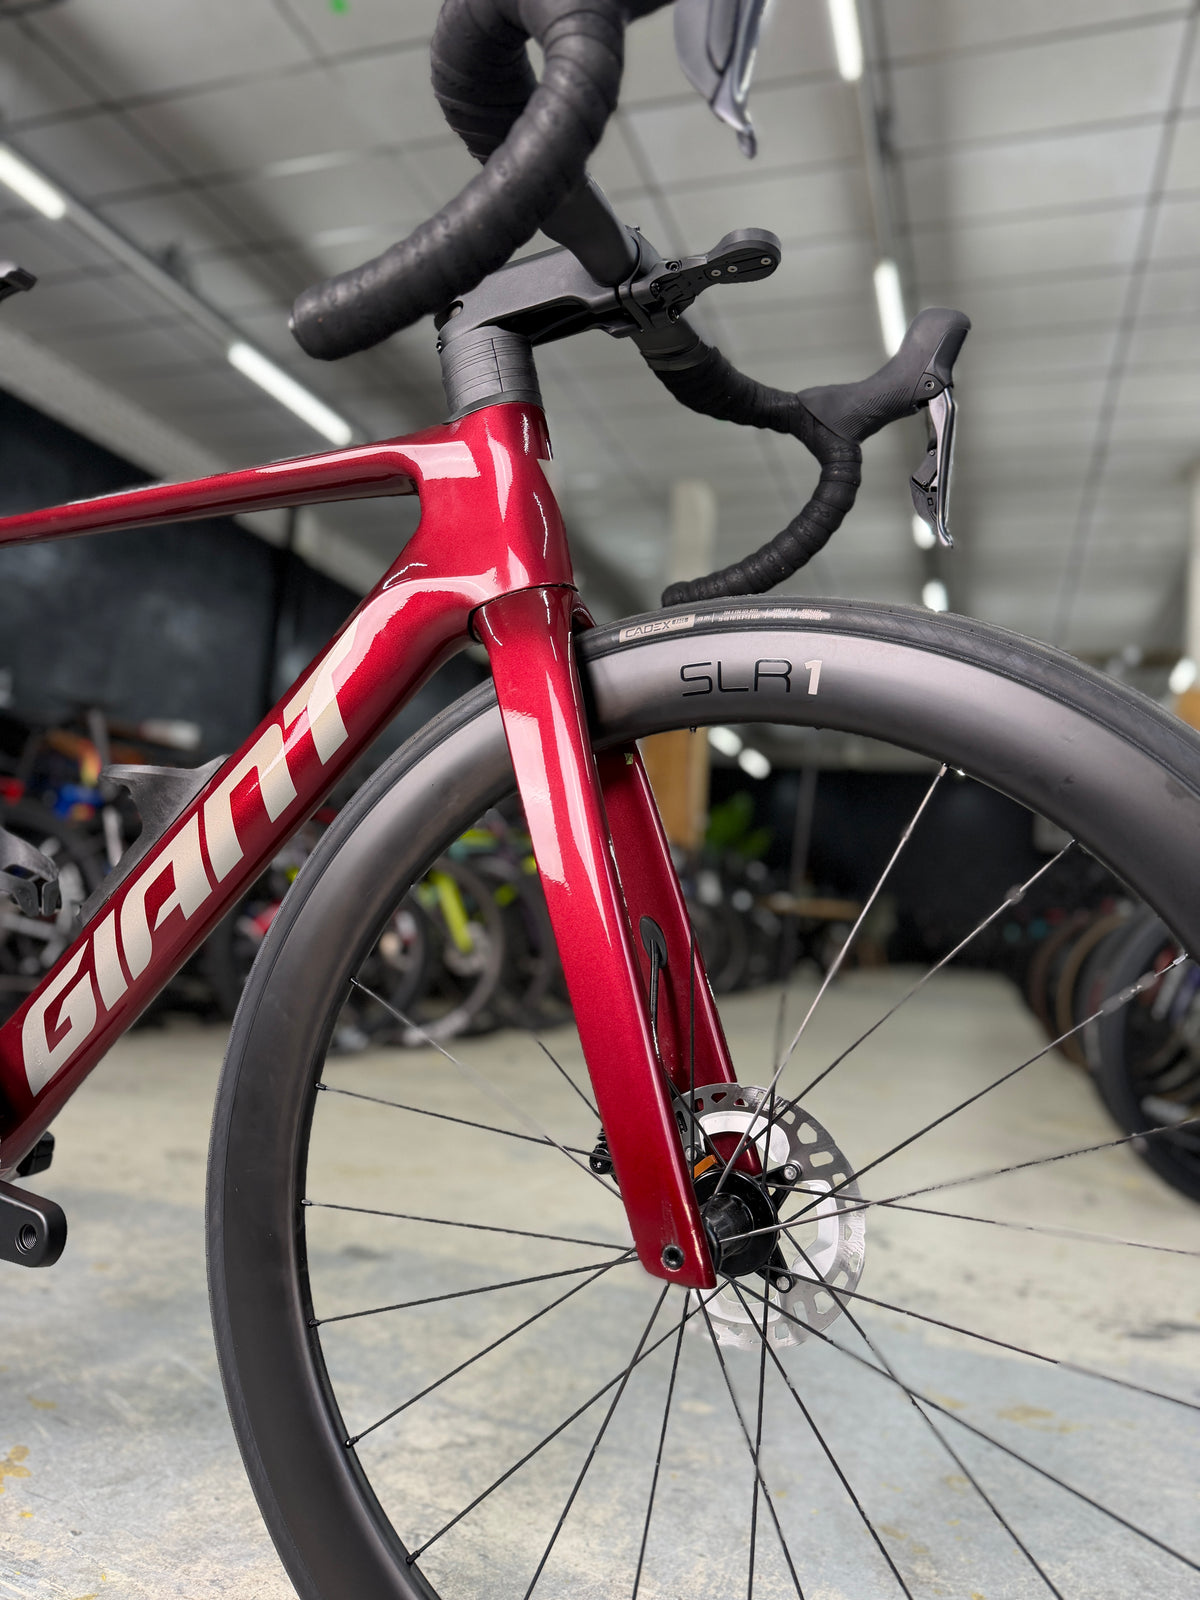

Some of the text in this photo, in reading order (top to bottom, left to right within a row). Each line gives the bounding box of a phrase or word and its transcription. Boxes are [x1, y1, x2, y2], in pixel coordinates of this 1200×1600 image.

[625, 620, 671, 638] CADEX
[680, 657, 823, 697] SLR 1
[22, 611, 363, 1097] GIANT
